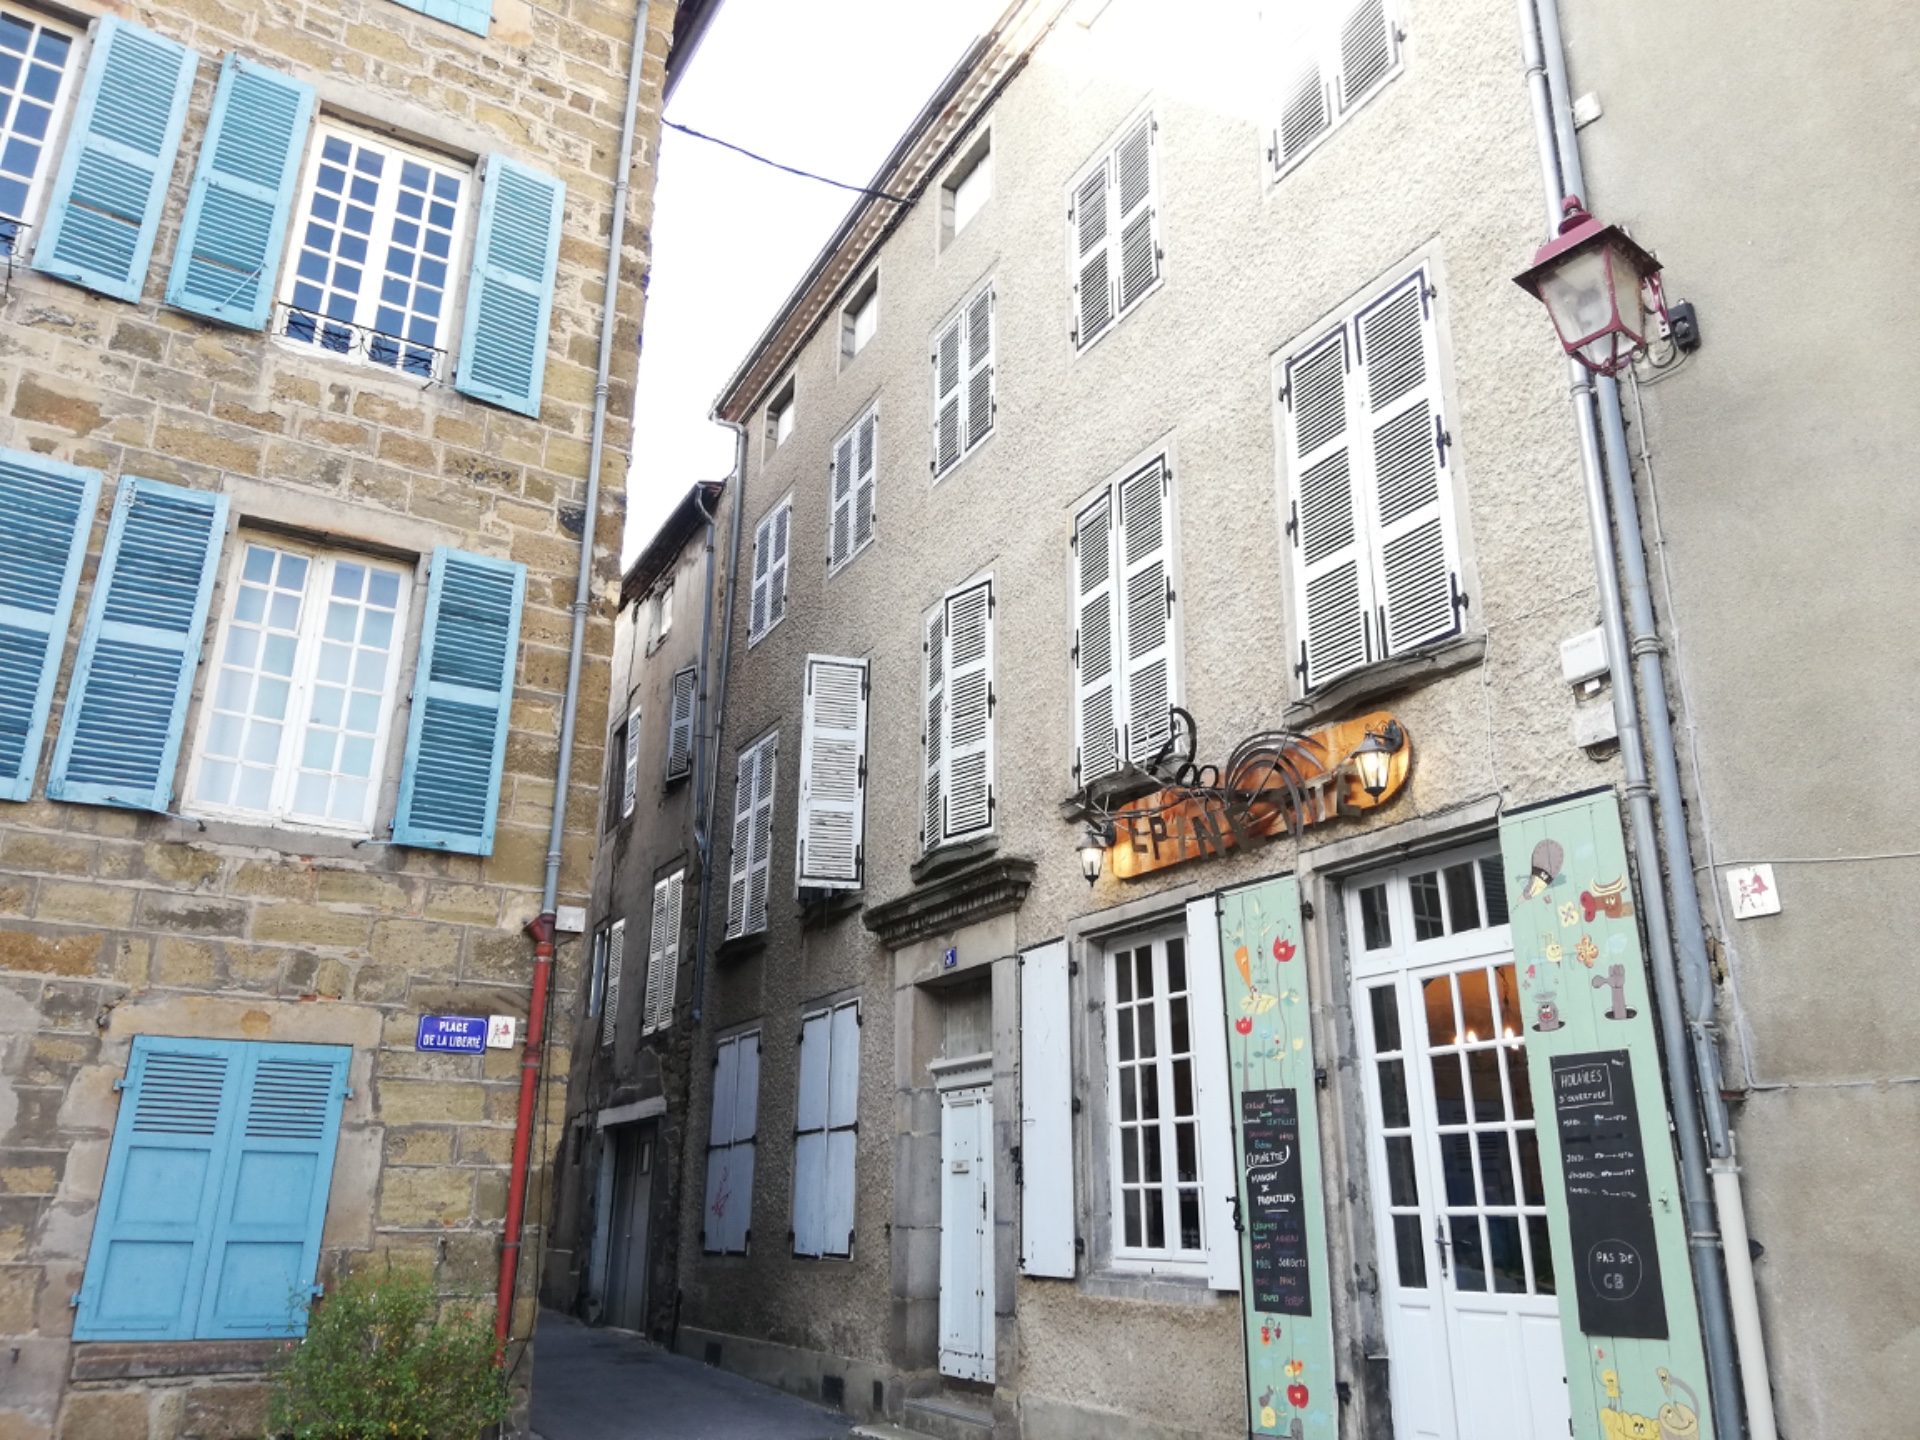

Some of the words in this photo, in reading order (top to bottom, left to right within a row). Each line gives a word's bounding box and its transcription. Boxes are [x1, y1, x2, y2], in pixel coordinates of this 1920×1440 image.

[439, 1021, 469, 1033] PLACE
[423, 1034, 434, 1046] DE
[437, 1035, 447, 1047] LA
[449, 1035, 481, 1049] LIBERTÉ
[1596, 1252, 1614, 1263] PAS
[1620, 1252, 1634, 1263] DE
[1604, 1272, 1624, 1288] CB
